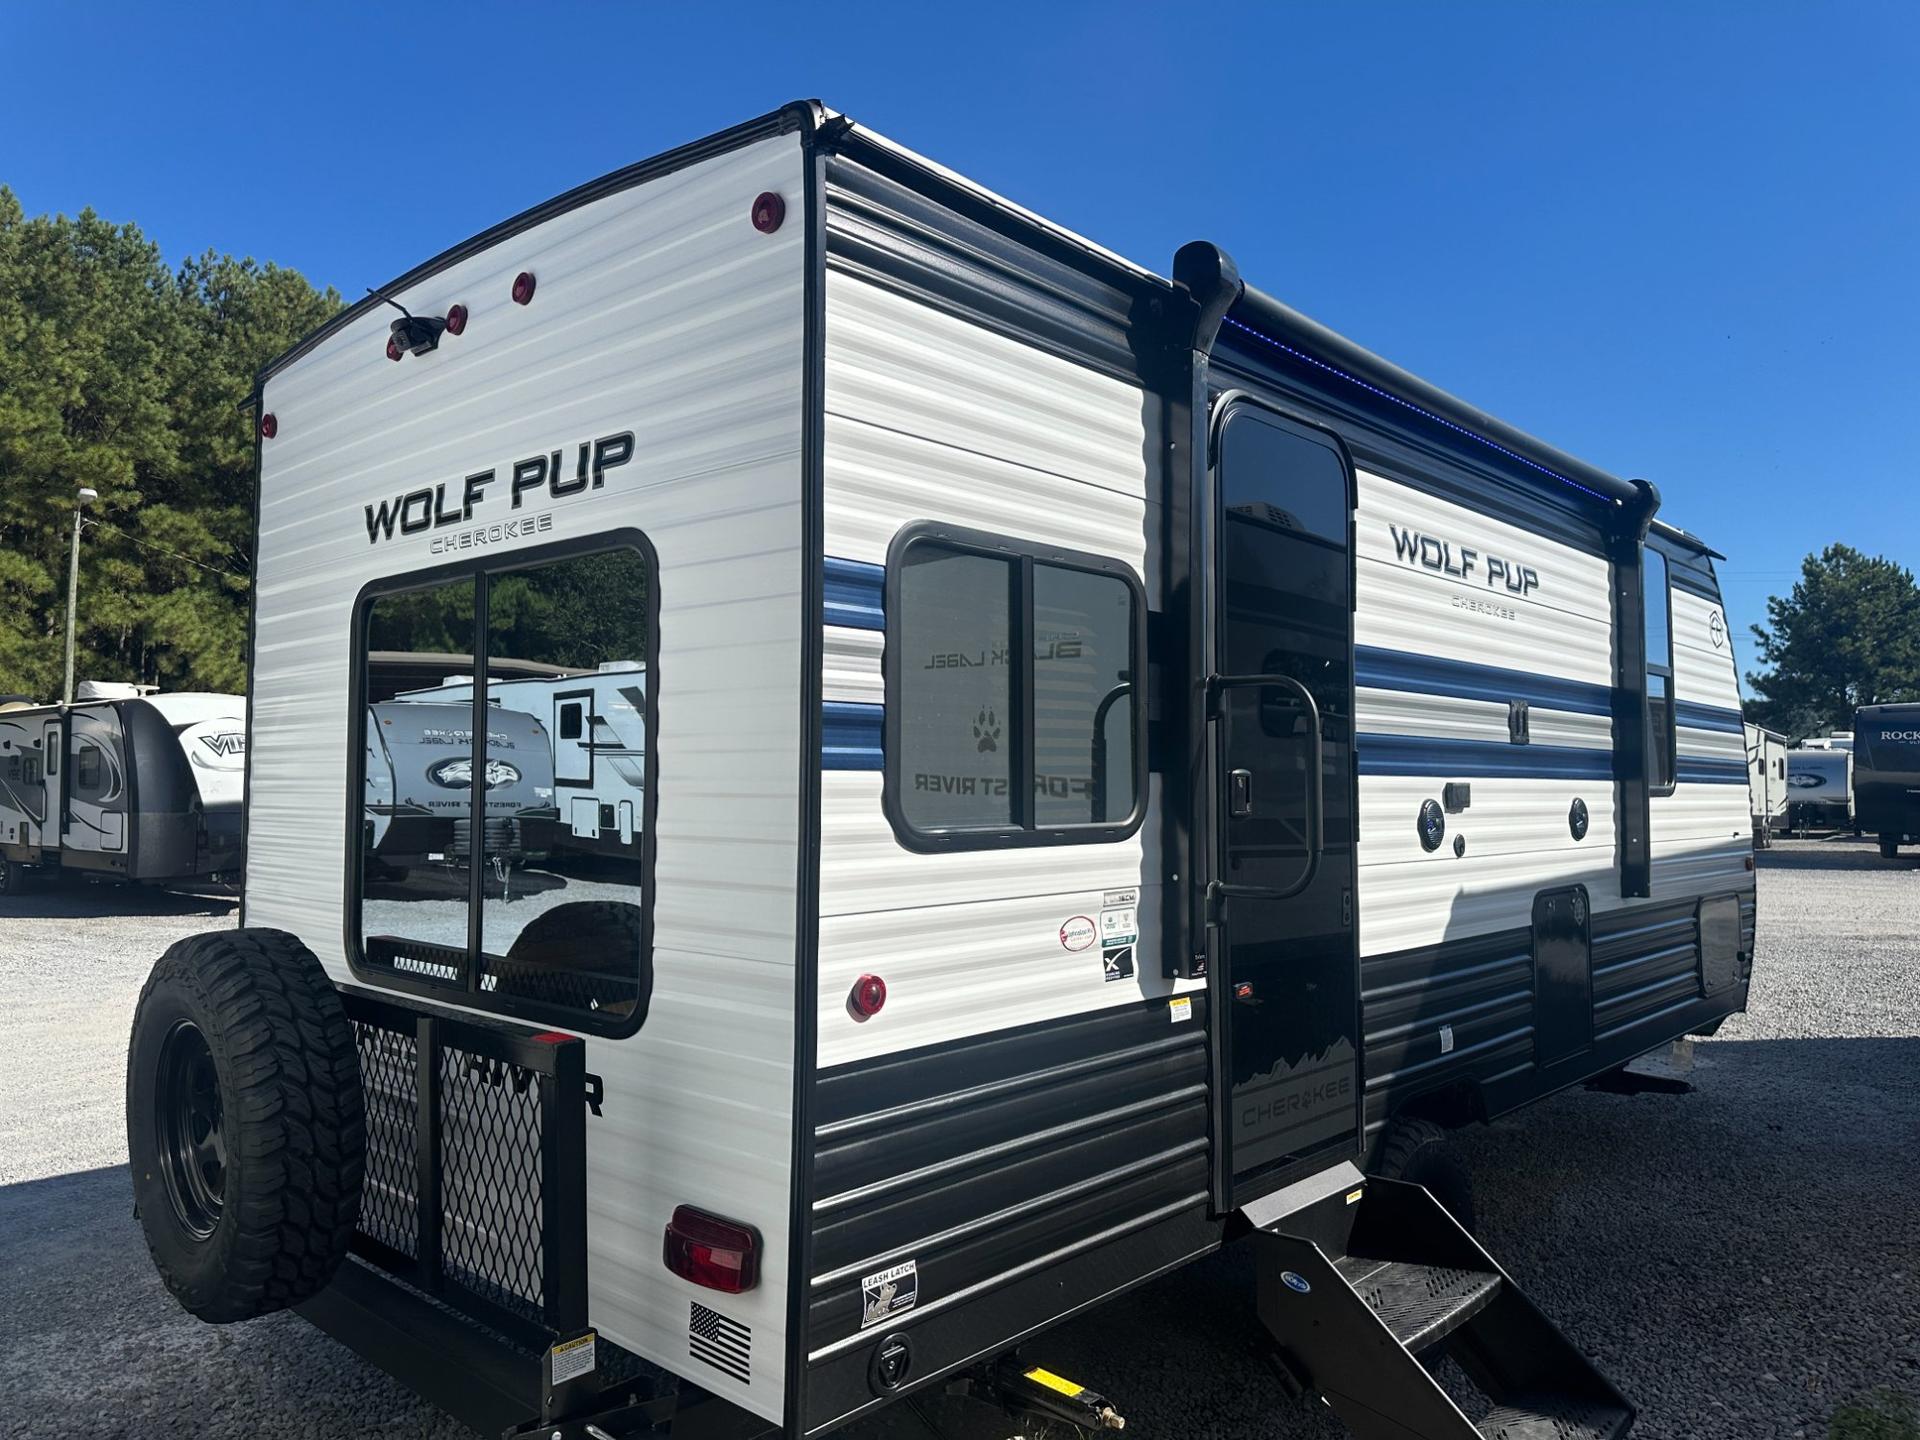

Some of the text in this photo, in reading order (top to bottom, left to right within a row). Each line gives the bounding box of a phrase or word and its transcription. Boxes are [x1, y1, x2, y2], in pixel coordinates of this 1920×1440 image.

[364, 430, 636, 544] WOLF PUP
[430, 513, 553, 554] CHEROKEE
[1389, 523, 1540, 597] WOLF PUP
[1452, 594, 1516, 621] CHEROKEE
[863, 1263, 915, 1287] LEASH LATCH
